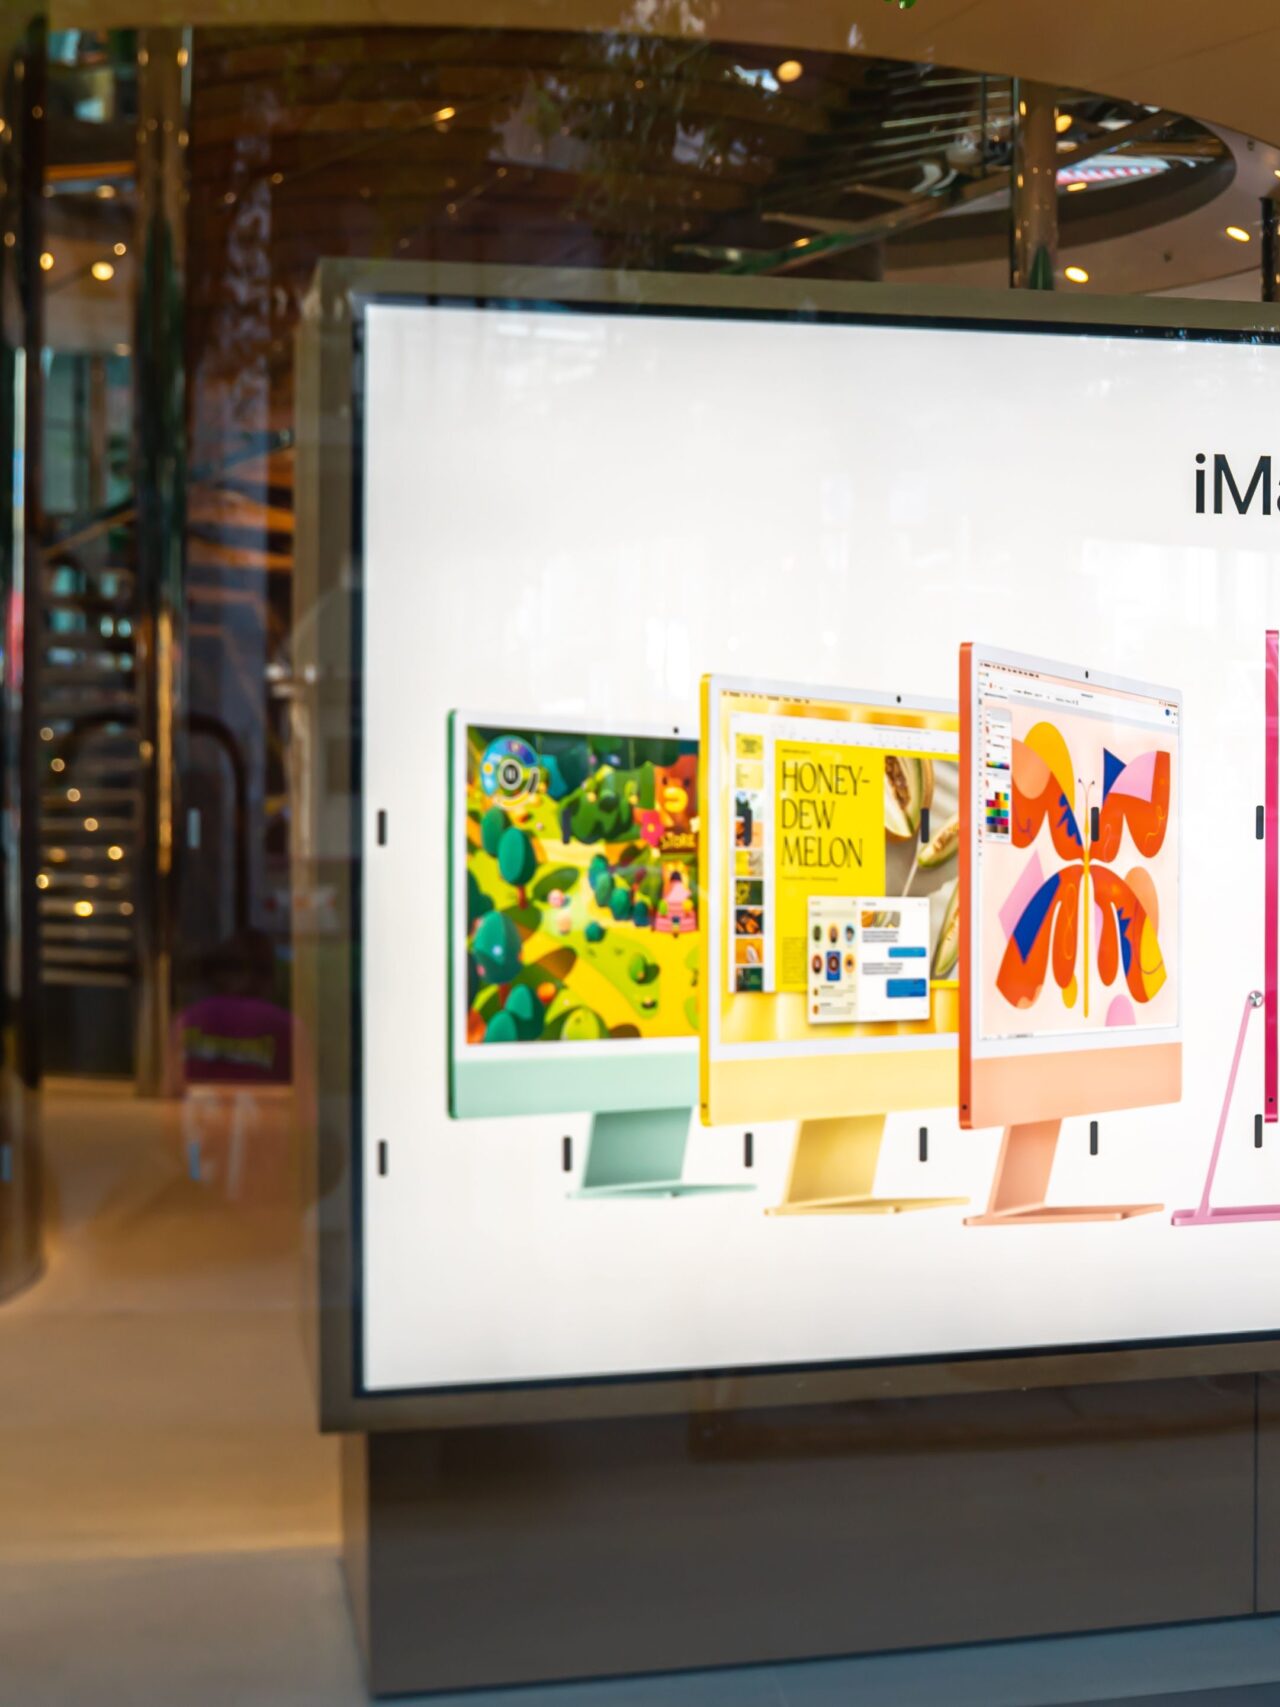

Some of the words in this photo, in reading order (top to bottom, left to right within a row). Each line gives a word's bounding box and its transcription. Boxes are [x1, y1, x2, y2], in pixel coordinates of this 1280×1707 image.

[781, 760, 870, 795] HONEY-
[781, 799, 836, 829] DEW
[781, 836, 862, 868] MELON
